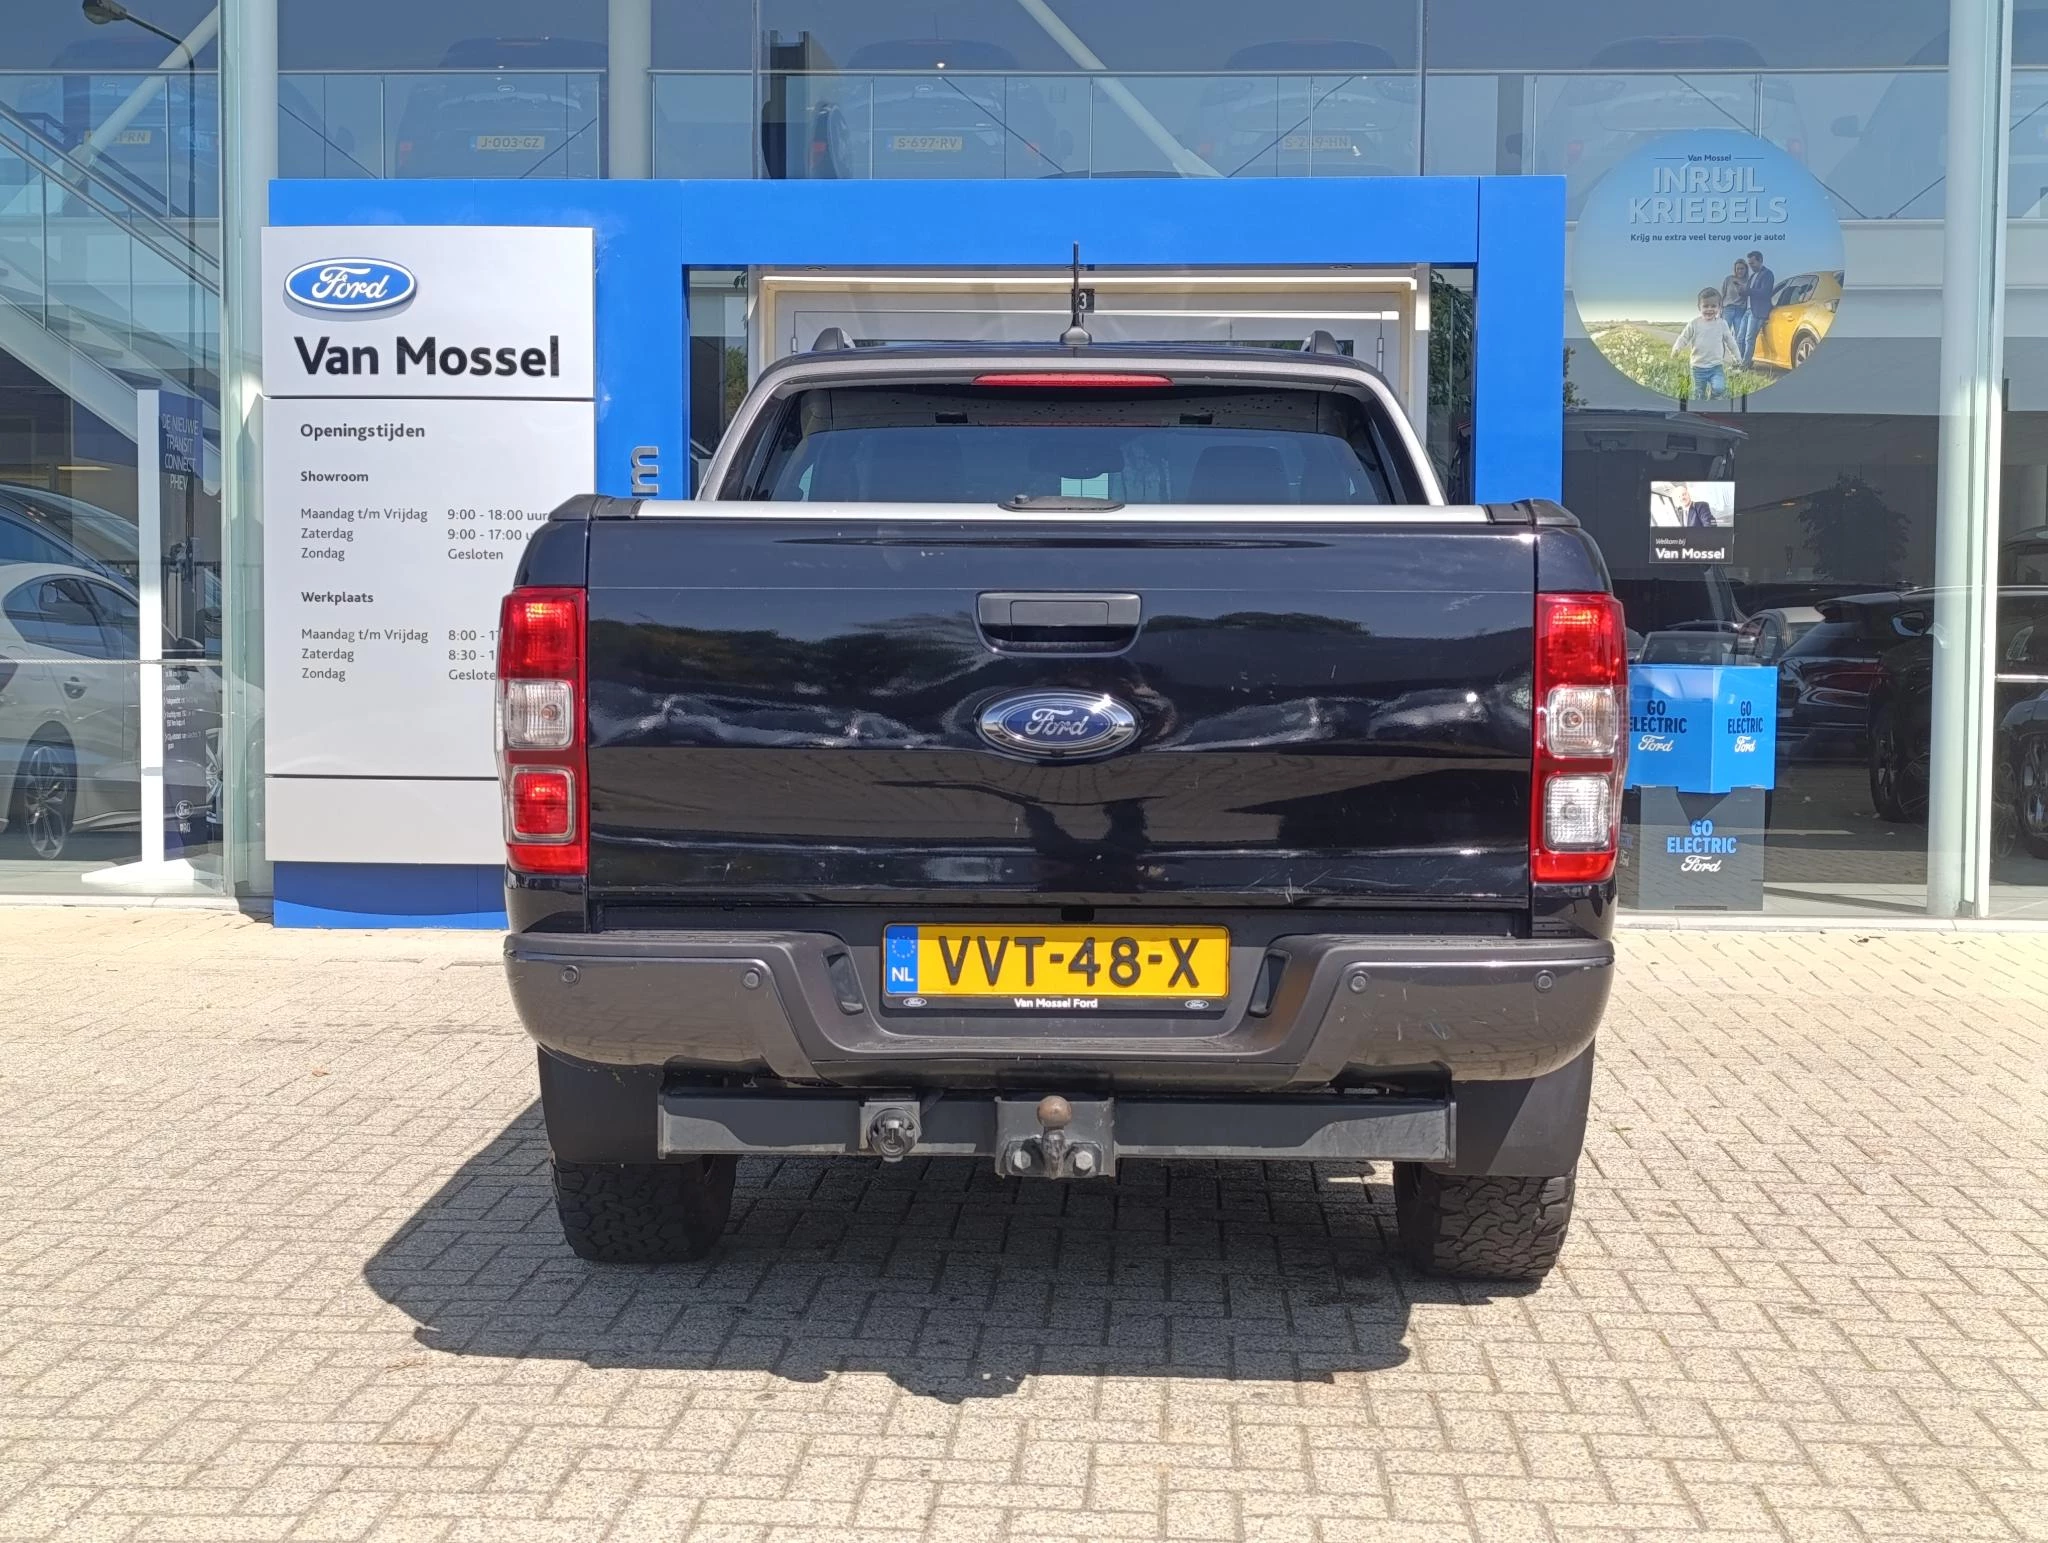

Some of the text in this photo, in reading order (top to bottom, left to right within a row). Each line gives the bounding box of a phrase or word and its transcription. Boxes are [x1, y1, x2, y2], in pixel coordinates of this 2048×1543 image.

[1704, 154, 1732, 162] Mossel
[1654, 167, 1765, 193] INRUIL
[1630, 197, 1788, 224] KRIEBELS
[1630, 233, 1650, 242] Krijg
[1689, 233, 1706, 241] veel
[1708, 234, 1731, 243] terug
[1753, 234, 1762, 243] je
[1764, 233, 1786, 241] auto!
[311, 266, 388, 299] Ford
[294, 335, 559, 377] Van Mossel
[172, 415, 199, 436] NIEUWE
[300, 424, 425, 441] Openingstijden
[166, 434, 193, 453] TRANSIT
[164, 453, 196, 472] CONNECT
[170, 474, 188, 490] PHEV
[300, 471, 369, 482] Showroom
[301, 508, 428, 522] Maandag t/m Vrijdag
[447, 510, 476, 520] 9:00
[488, 510, 523, 521] 18:00
[301, 528, 354, 542] Zaterdag
[447, 529, 476, 540] 9:00
[488, 530, 522, 541] 17:00
[301, 547, 345, 562] Zondag
[448, 549, 504, 560] Gesloten
[1656, 548, 1725, 559] Van Mossel
[301, 591, 374, 605] Werkplaats
[302, 628, 429, 643] Maandag t/m Vrijdag
[448, 630, 477, 640] 8:00
[302, 648, 354, 662] Zaterdag
[448, 650, 477, 660] 8:30
[302, 667, 346, 682] Zondag
[1647, 700, 1666, 716] GO
[1740, 701, 1751, 716] GO
[1025, 708, 1089, 736] Ford
[1728, 718, 1763, 734] ELECTRIC
[1638, 735, 1673, 752] Ford
[1734, 736, 1756, 752] Ford
[1691, 820, 1713, 836] GO
[1666, 837, 1737, 854] ELECTRIC
[1681, 855, 1721, 872] Ford
[892, 936, 1200, 988] NL VVT-48-X
[1014, 998, 1098, 1008] Van Mossel Ford
